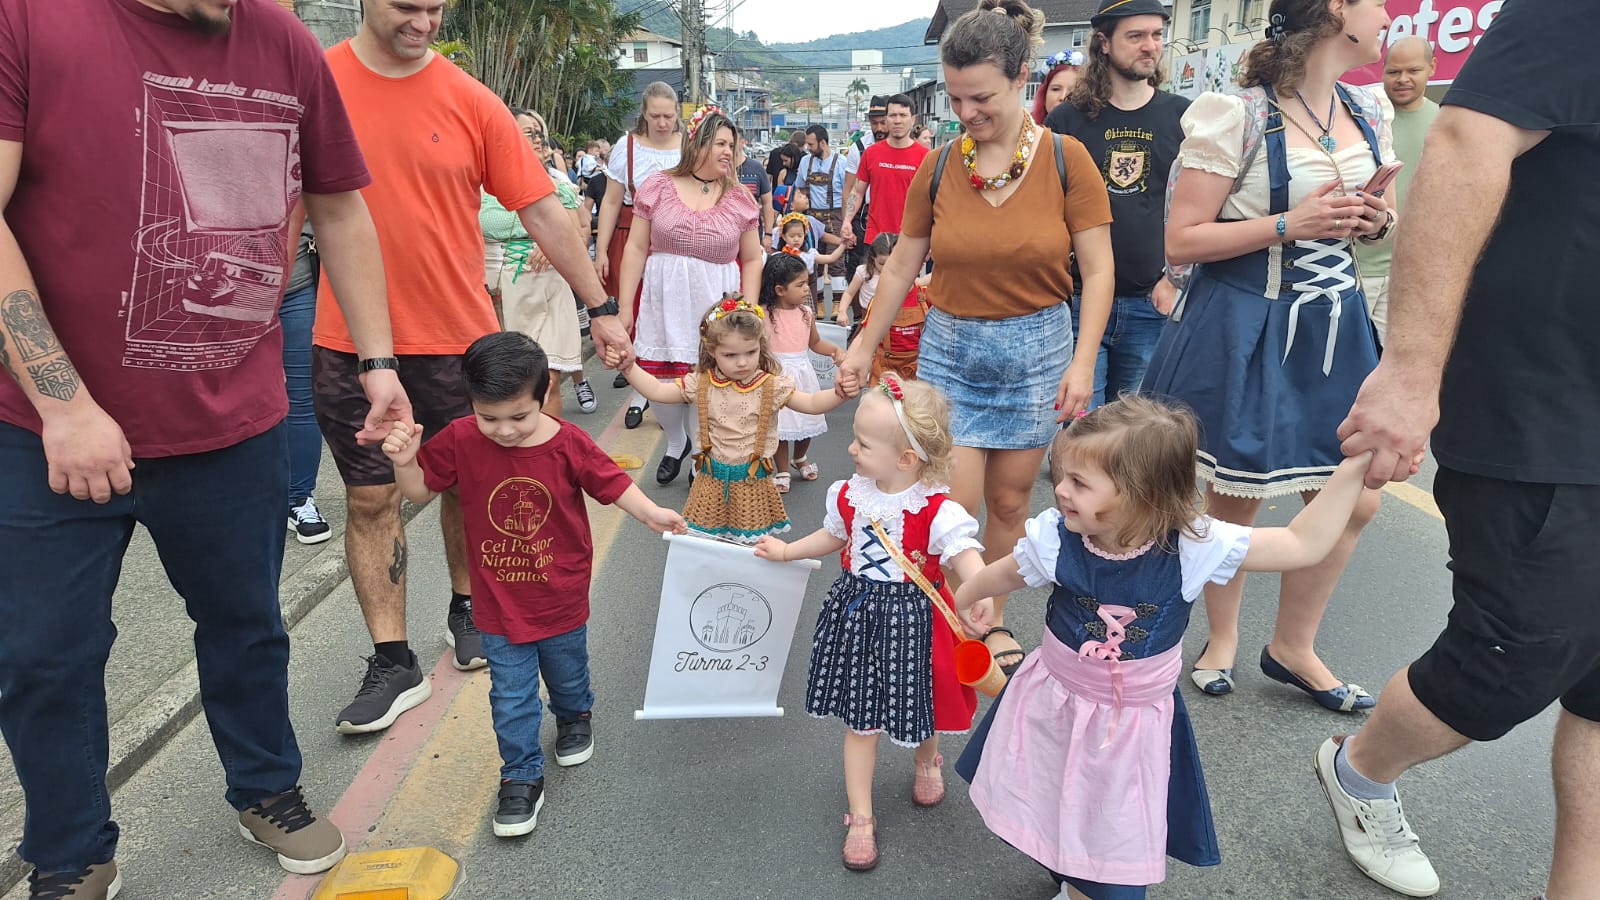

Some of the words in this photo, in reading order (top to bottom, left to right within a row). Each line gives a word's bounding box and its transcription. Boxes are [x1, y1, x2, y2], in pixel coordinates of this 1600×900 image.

[1376, 0, 1502, 53] etes
[1104, 126, 1153, 141] Oktoberfest
[480, 539, 507, 553] Cei
[511, 536, 554, 555] Pastor
[481, 554, 530, 568] Nirton
[534, 552, 554, 569] dos
[496, 569, 549, 583] Santos
[674, 651, 733, 673] Turma
[736, 654, 769, 671] 2-3
